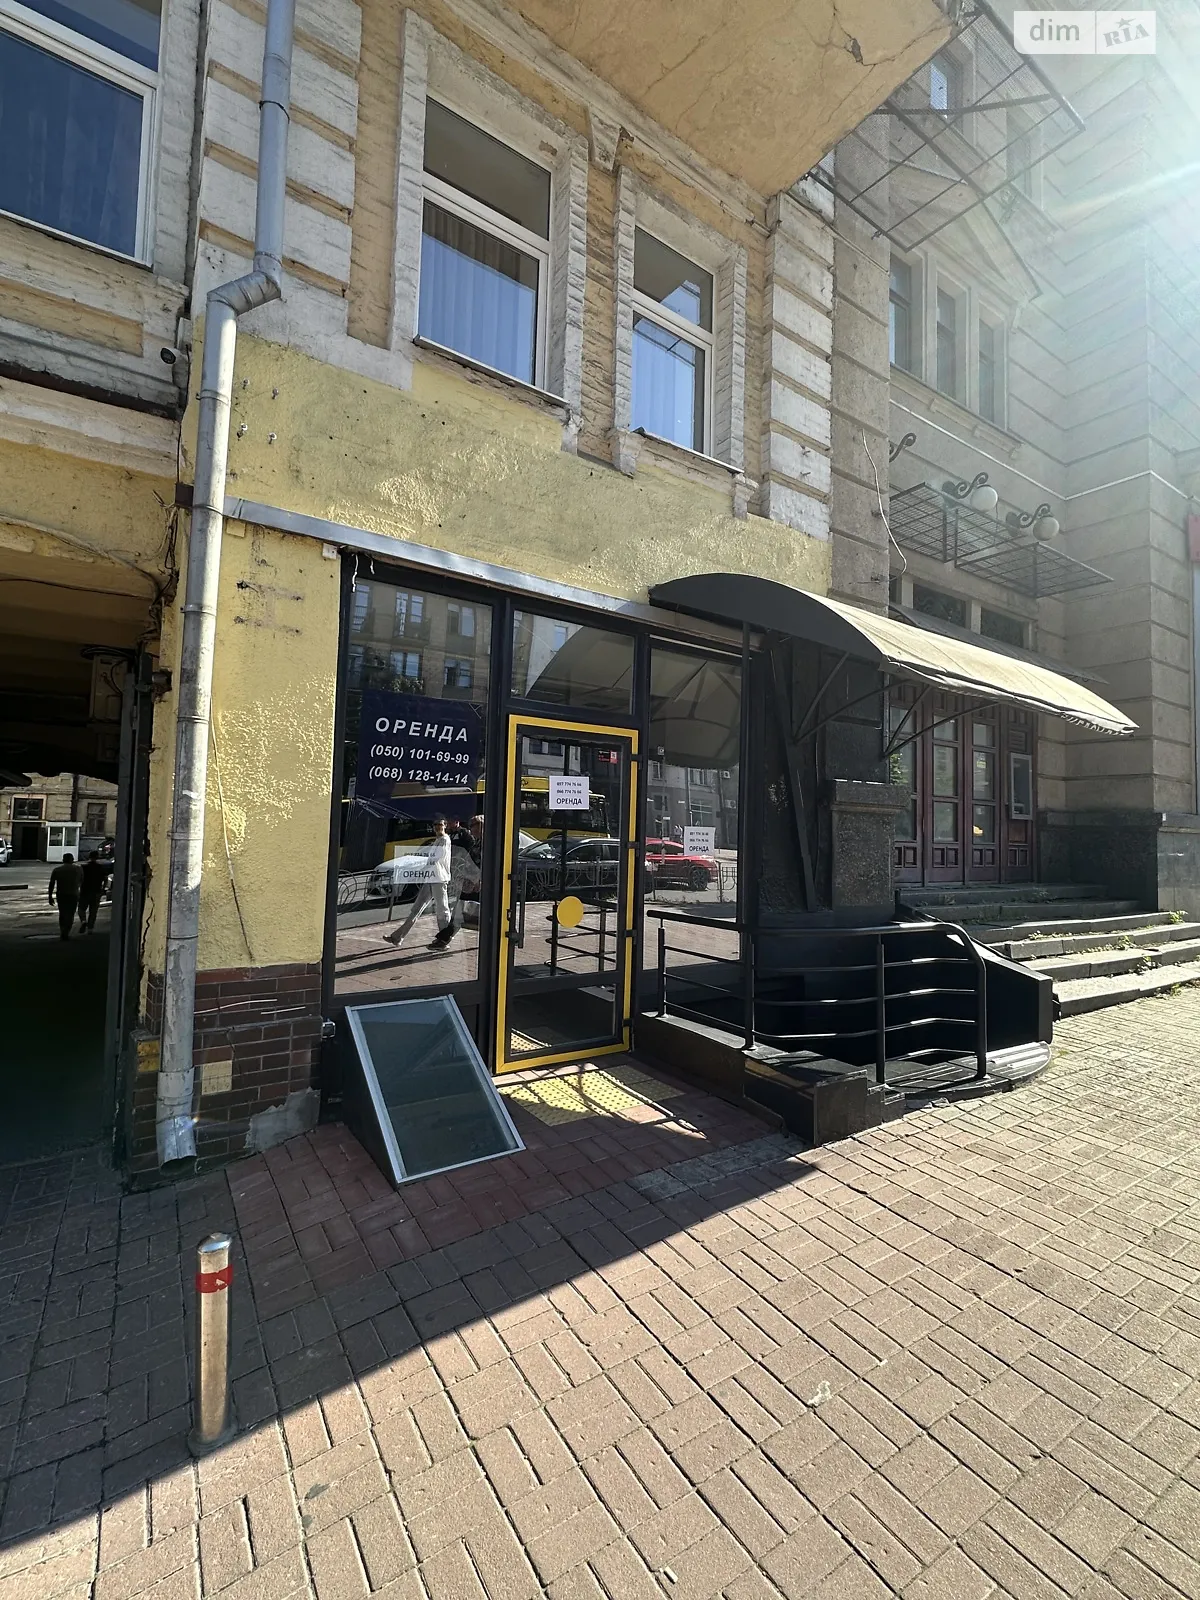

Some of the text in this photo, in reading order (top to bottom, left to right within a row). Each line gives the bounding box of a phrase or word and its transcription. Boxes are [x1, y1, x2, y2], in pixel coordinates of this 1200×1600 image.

[375, 717, 468, 743] ОРЕНДА
[370, 744, 470, 764] (050) 101-69-99
[369, 765, 468, 785] (068) 128-14-14
[556, 797, 583, 806] ОРЕНДА
[403, 870, 436, 879] ОРЕНДА
